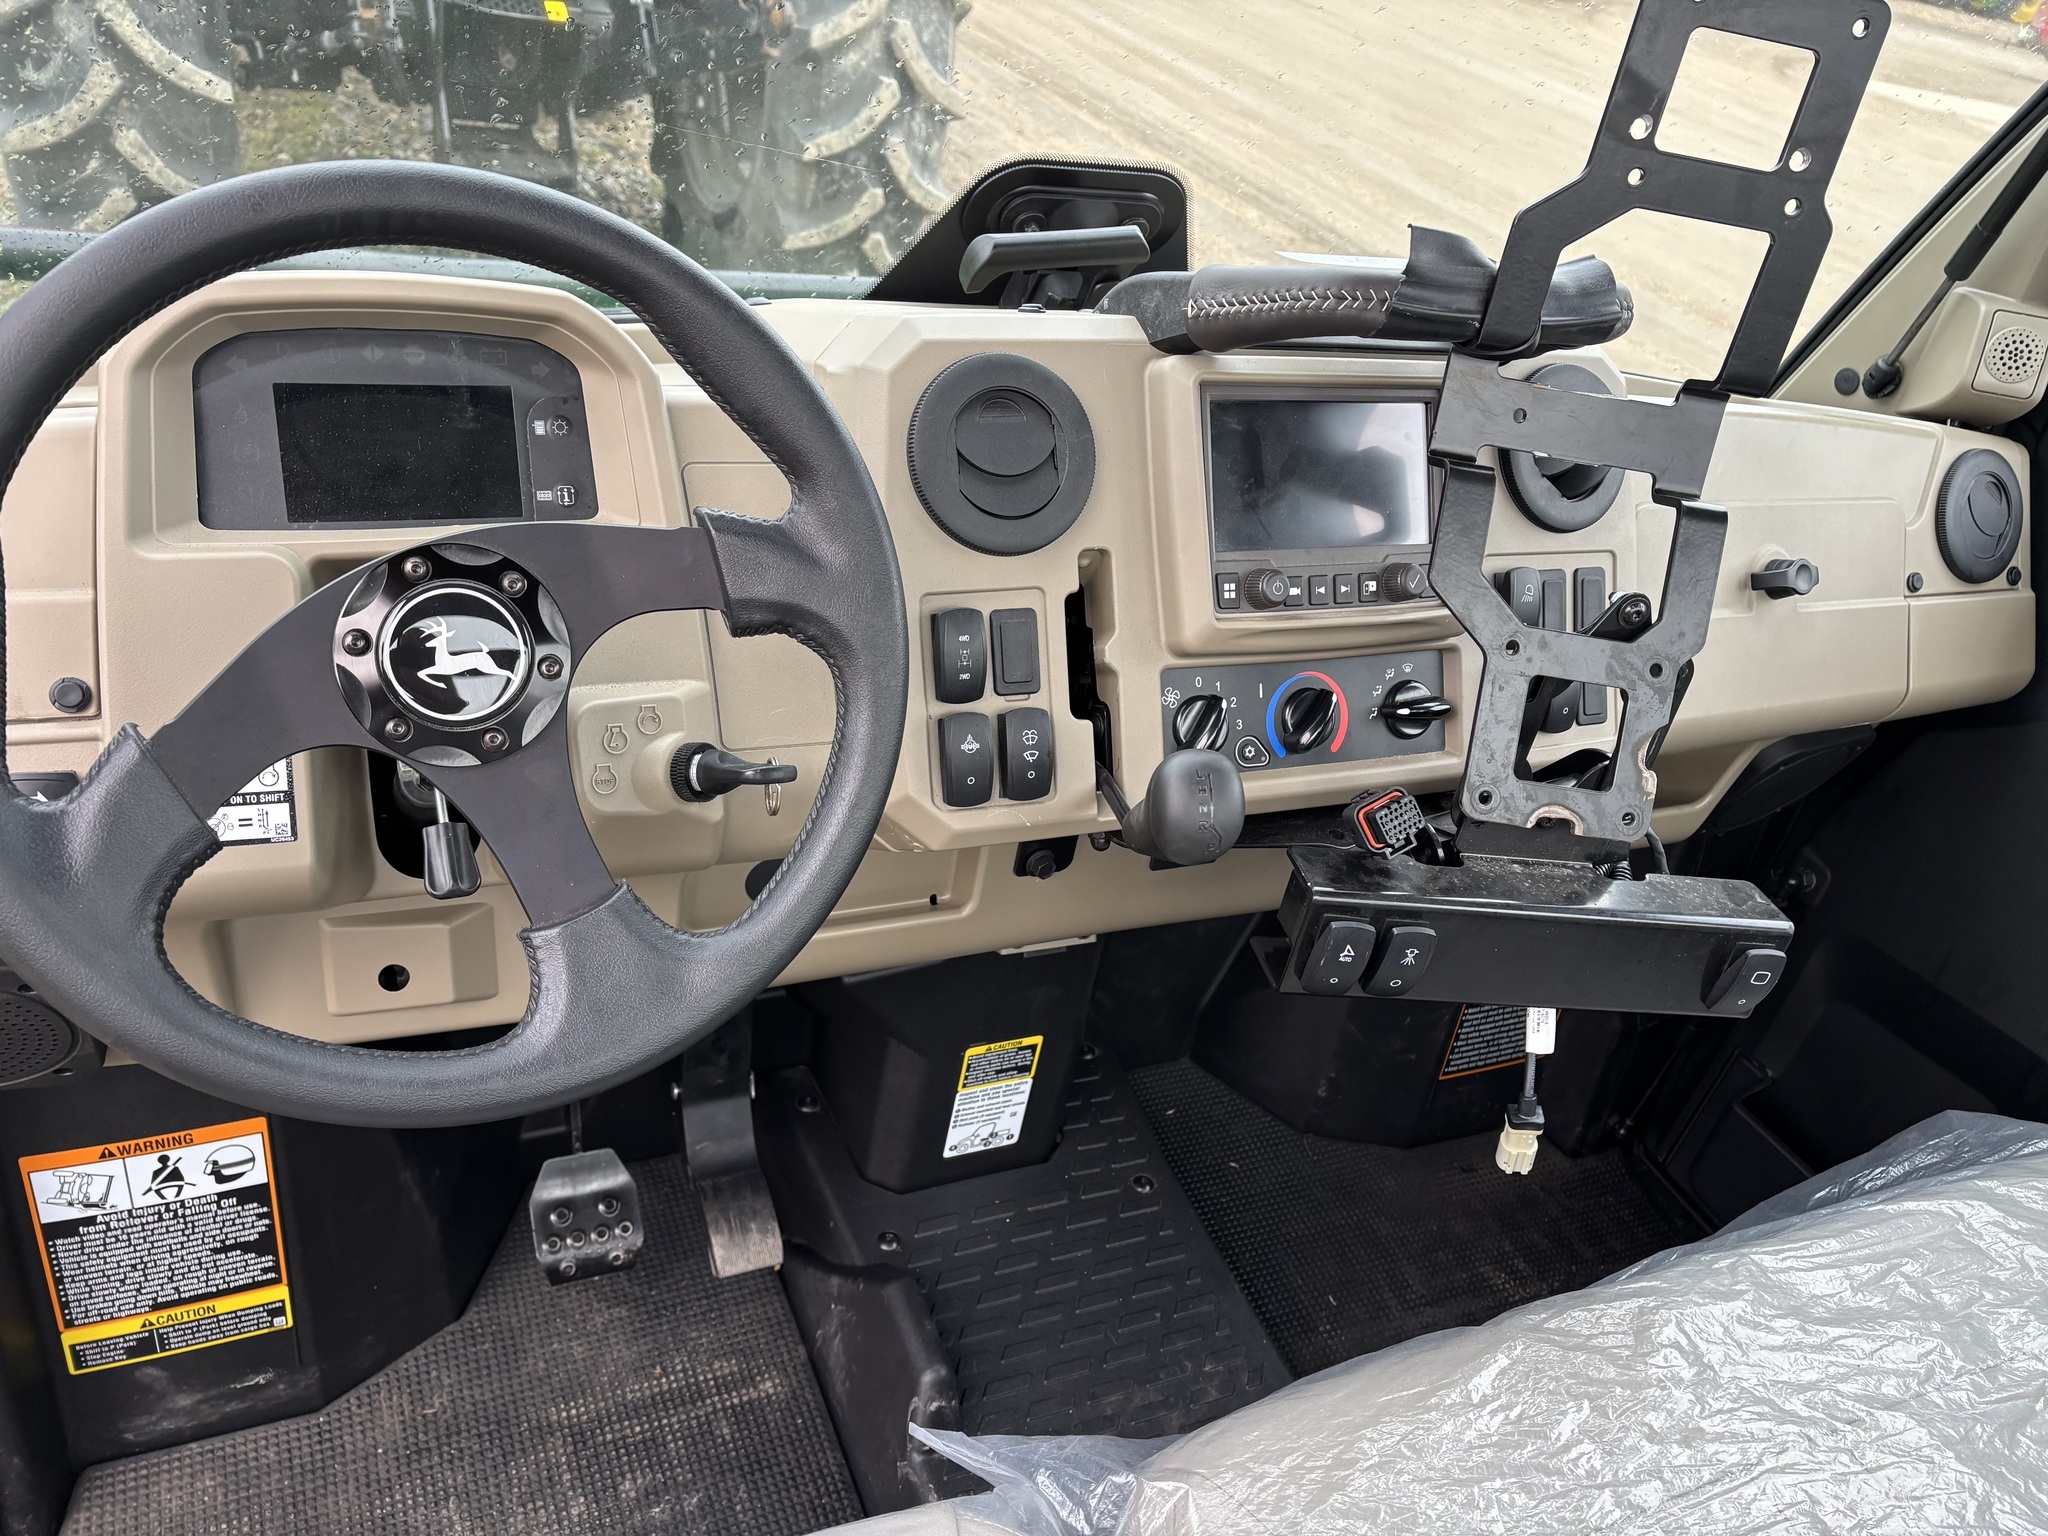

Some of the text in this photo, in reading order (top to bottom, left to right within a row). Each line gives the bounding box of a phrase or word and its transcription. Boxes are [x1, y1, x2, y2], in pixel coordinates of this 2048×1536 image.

[1195, 677, 1202, 688] 0
[1215, 681, 1220, 692] 1
[1230, 698, 1236, 708] 2
[1236, 720, 1242, 730] 3
[1196, 769, 1204, 780] L
[230, 793, 285, 804] ON TO SHIFT
[1198, 786, 1208, 796] H
[1199, 803, 1208, 812] N
[1198, 820, 1208, 832] R
[993, 1040, 1023, 1050] CAUTION
[116, 1133, 193, 1156] WARNING
[78, 1223, 106, 1234] from
[109, 1214, 158, 1229] Rollover
[177, 1202, 217, 1216] Falling
[220, 1197, 236, 1207] Off
[96, 1210, 128, 1223] Avoid
[132, 1204, 165, 1216] Injury
[184, 1194, 217, 1206] Death
[54, 1236, 80, 1245] Watch
[82, 1232, 104, 1240] video
[123, 1224, 141, 1232] read
[185, 1209, 215, 1221] manual
[216, 1205, 242, 1215] before
[56, 1243, 81, 1251] Driver
[83, 1237, 103, 1246] must
[129, 1228, 151, 1239] years
[153, 1225, 166, 1233] old
[167, 1222, 185, 1230] with
[193, 1216, 213, 1225] valid
[215, 1212, 238, 1221] driver
[57, 1249, 81, 1257] Never
[105, 1239, 129, 1249] under
[145, 1230, 182, 1241] influence
[194, 1221, 222, 1232] alcohol
[59, 1254, 88, 1263] Vehicle
[98, 1245, 134, 1257] equipped
[153, 1236, 187, 1246] seatbelts
[222, 1224, 243, 1233] doors
[79, 1258, 104, 1267] safety
[106, 1249, 148, 1262] equipment
[150, 1245, 169, 1253] must
[183, 1238, 202, 1247] used
[85, 1260, 117, 1272] helmets
[119, 1257, 140, 1266] when
[142, 1252, 170, 1262] driving
[236, 1233, 258, 1242] rough
[64, 1281, 85, 1289] Keep
[87, 1276, 107, 1284] arms
[144, 1263, 168, 1273] inside
[170, 1258, 198, 1268] vehicle
[200, 1253, 225, 1262] during
[73, 1271, 102, 1281] uneven
[156, 1254, 181, 1265] higher
[66, 1286, 89, 1294] While
[124, 1275, 144, 1283] drive
[146, 1270, 171, 1280] slowly
[67, 1293, 89, 1301] Drive
[90, 1287, 116, 1296] slowly
[117, 1283, 139, 1291] when
[184, 1269, 206, 1278] rough
[218, 1261, 245, 1271] uneven
[80, 1295, 103, 1306] paved
[162, 1277, 198, 1289] operating
[207, 1270, 226, 1279] night
[87, 1301, 112, 1310] brakes
[113, 1296, 135, 1306] going
[136, 1292, 157, 1300] down
[178, 1282, 206, 1291] Vehicle
[87, 1304, 118, 1316] off-road
[119, 1302, 134, 1310] use
[157, 1292, 178, 1302] Avoid
[180, 1285, 216, 1298] operating
[229, 1277, 252, 1288] public
[74, 1316, 100, 1324] streets
[156, 1304, 215, 1325] CAUTION
